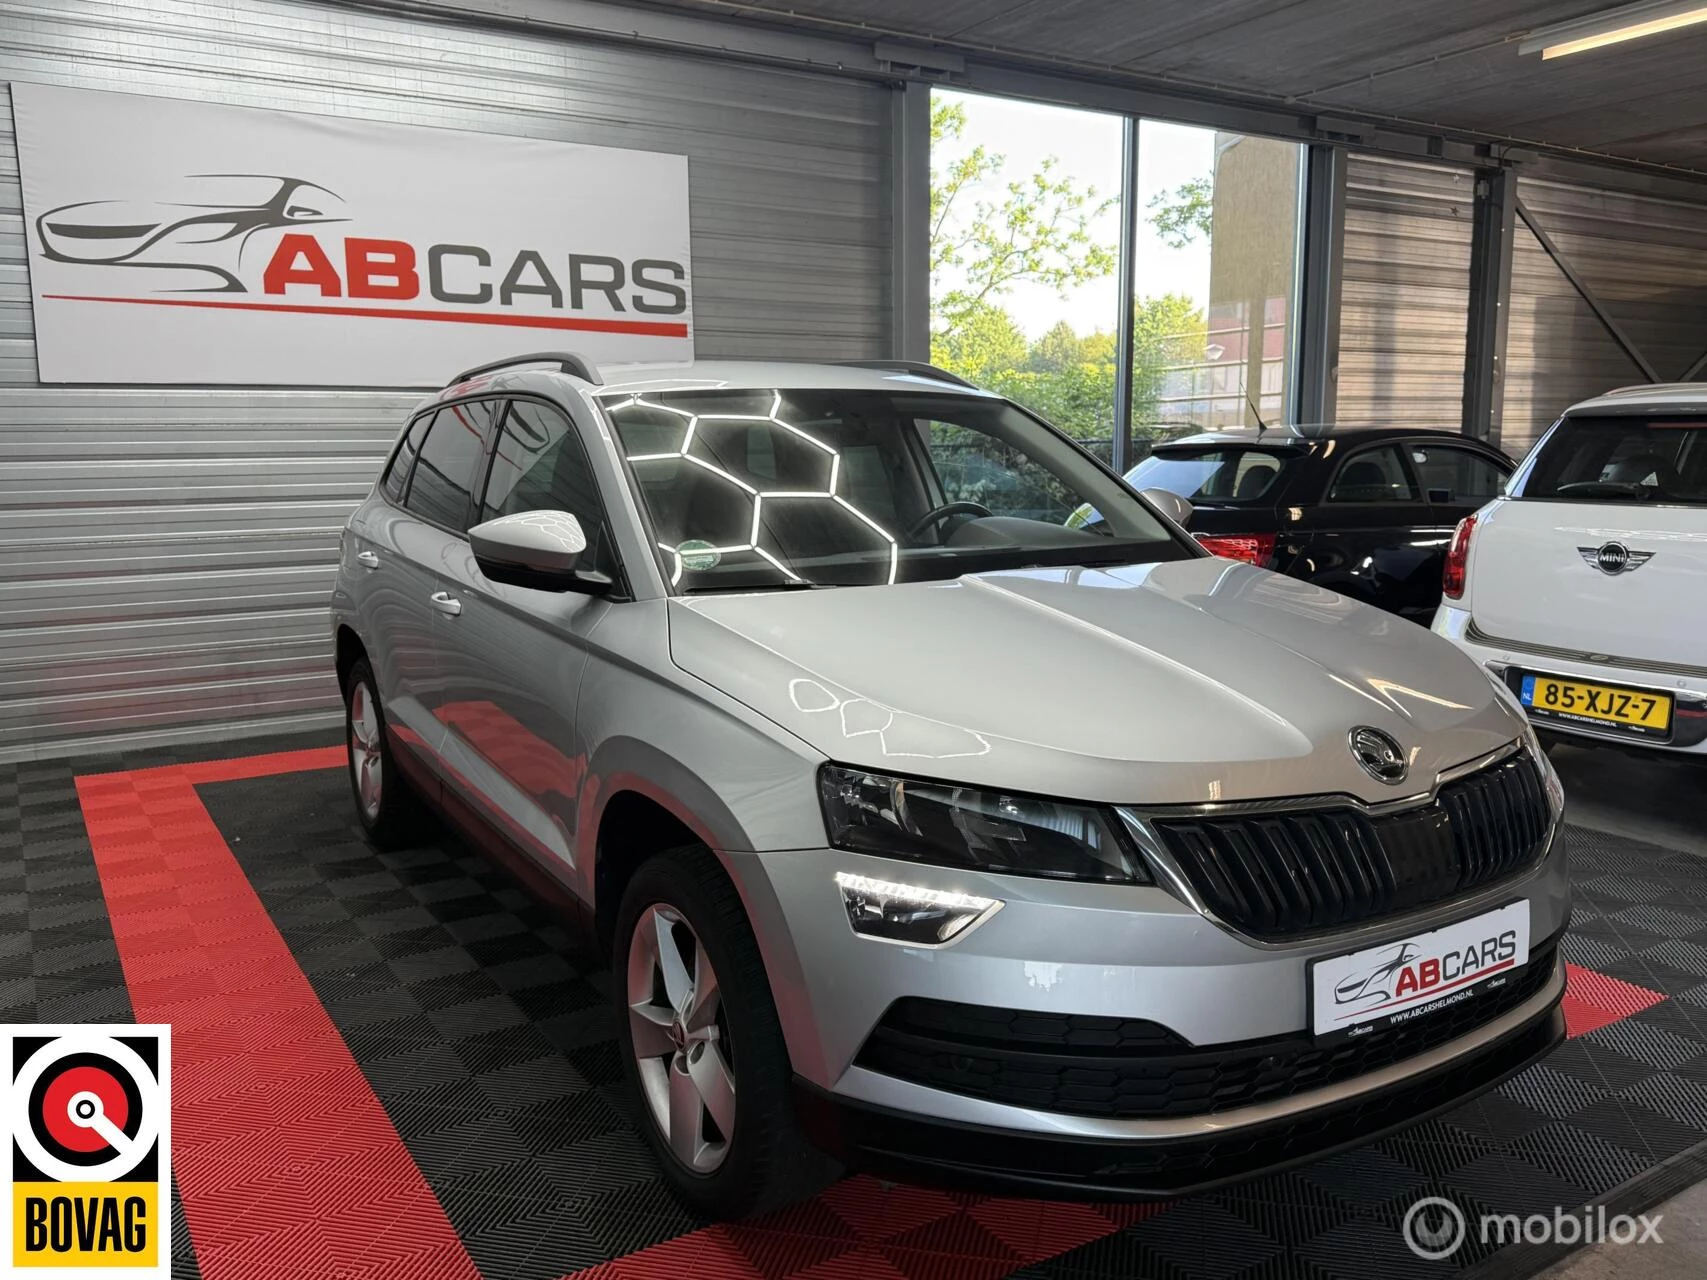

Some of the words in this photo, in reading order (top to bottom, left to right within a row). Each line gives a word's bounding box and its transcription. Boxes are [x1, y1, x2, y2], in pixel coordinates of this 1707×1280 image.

[263, 232, 687, 315] ABCARS
[1599, 552, 1625, 563] MINI
[1522, 692, 1532, 701] NL
[1544, 683, 1657, 721] 85-XJZ-7
[1395, 929, 1517, 998] ABCARS
[1390, 988, 1474, 1025] WWW.ABCARSHELMOND.NL
